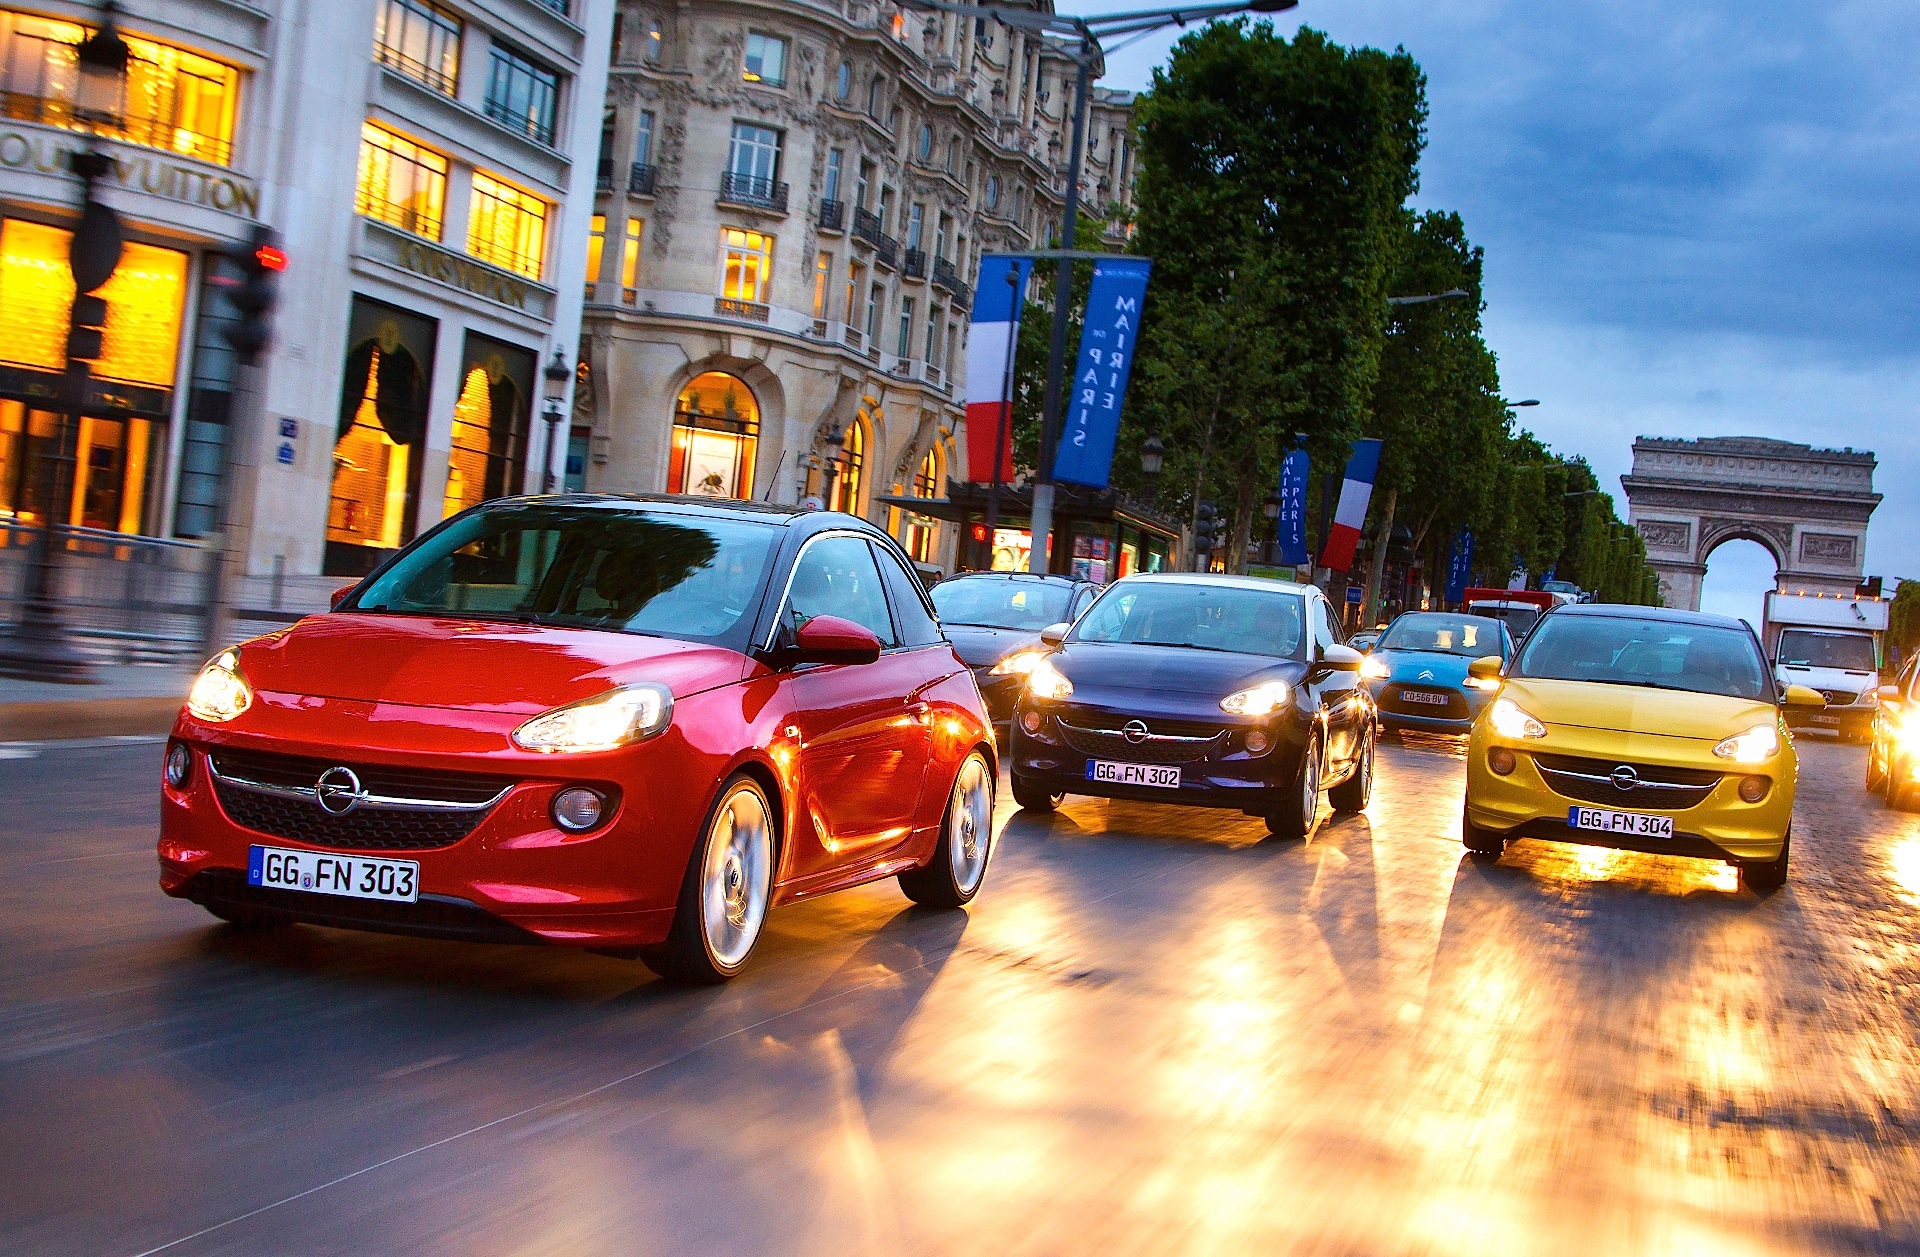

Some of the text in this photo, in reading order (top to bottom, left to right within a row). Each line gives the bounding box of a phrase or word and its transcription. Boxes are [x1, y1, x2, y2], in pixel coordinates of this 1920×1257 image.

[111, 152, 260, 219] VUITTON
[1281, 457, 1294, 521] MAIRIE
[1291, 488, 1300, 544] PARIS
[1096, 763, 1116, 780] GG
[1124, 766, 1146, 783] FN
[1148, 768, 1178, 786] 302
[1580, 810, 1602, 828] GG
[1611, 813, 1635, 831] FN
[1638, 816, 1671, 835] 304
[266, 853, 300, 885] GG
[315, 858, 352, 891] FN
[359, 862, 415, 897] 303
